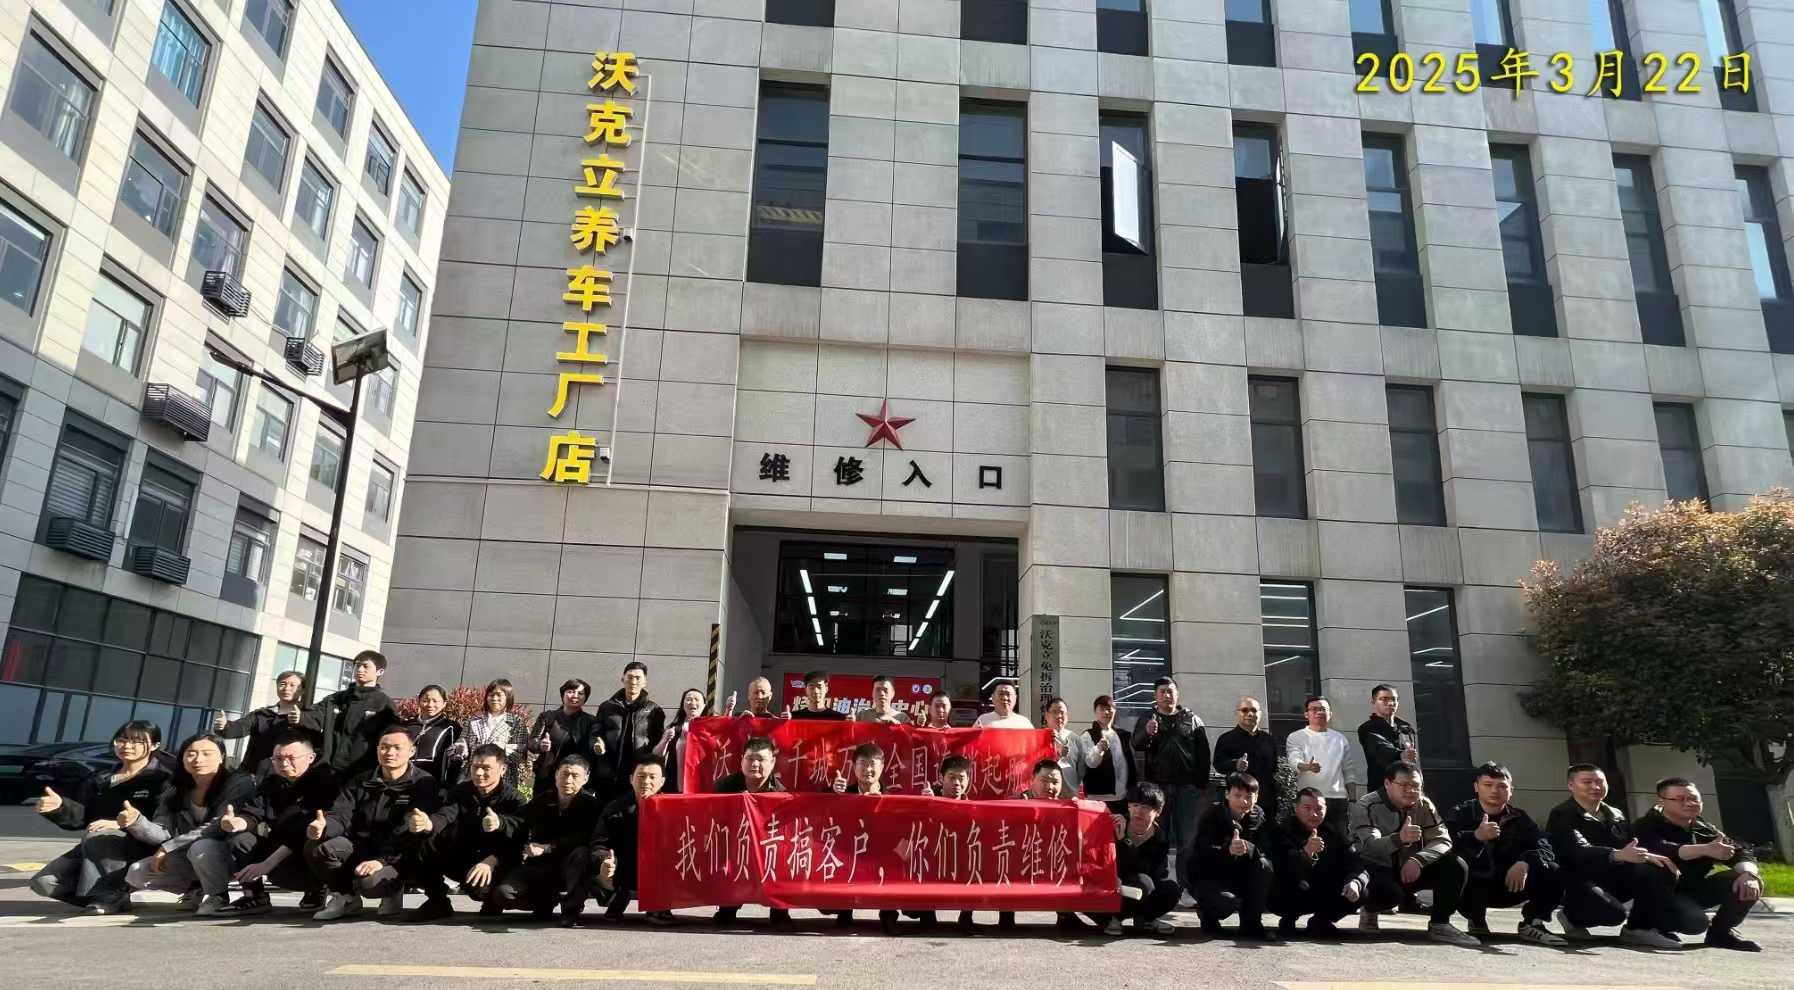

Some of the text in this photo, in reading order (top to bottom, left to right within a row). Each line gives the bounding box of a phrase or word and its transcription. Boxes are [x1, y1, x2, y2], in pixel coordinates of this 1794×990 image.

[540, 50, 640, 486] 沃克立养车工厂店
[759, 453, 1002, 490] 维修入口
